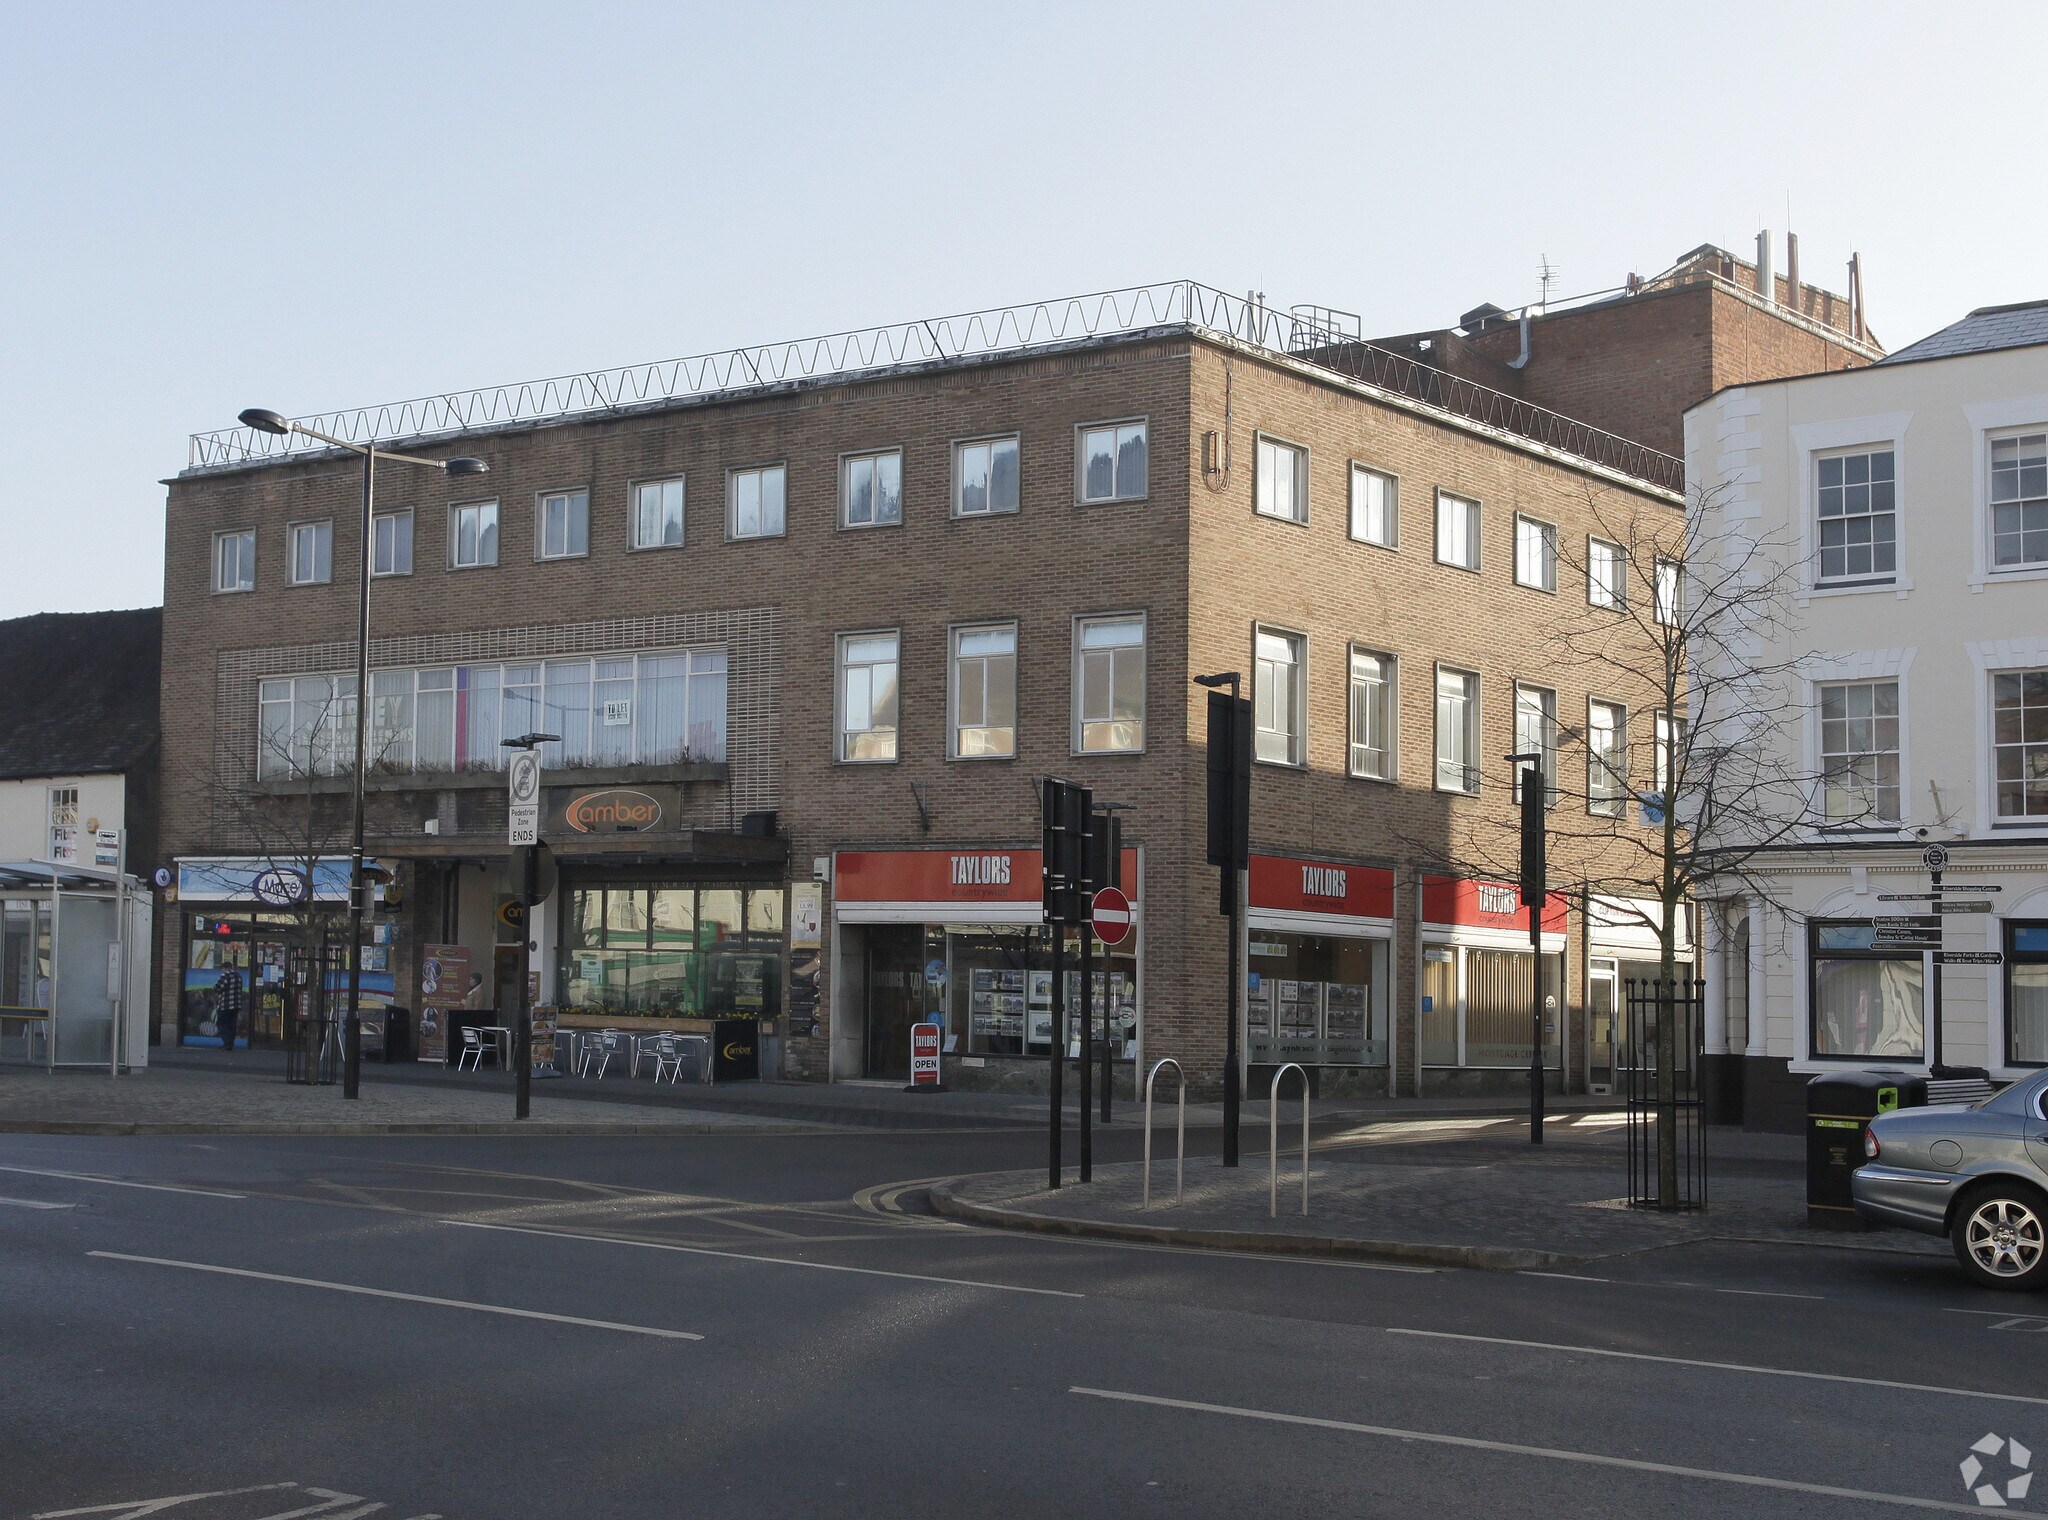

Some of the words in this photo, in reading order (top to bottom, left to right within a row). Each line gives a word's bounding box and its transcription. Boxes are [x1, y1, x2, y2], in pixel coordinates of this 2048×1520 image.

[607, 703, 616, 714] TO
[617, 702, 628, 713] LET
[511, 809, 536, 817] Pedestrian
[578, 799, 657, 823] amber
[517, 818, 529, 826] Zone
[512, 830, 534, 841] ENDS
[951, 855, 1011, 885] TAYLORS
[1302, 865, 1346, 898] TAYLORS
[1478, 885, 1516, 914] TAYLORS
[915, 1035, 937, 1047] TAYLORS
[915, 1060, 937, 1069] OPEN
